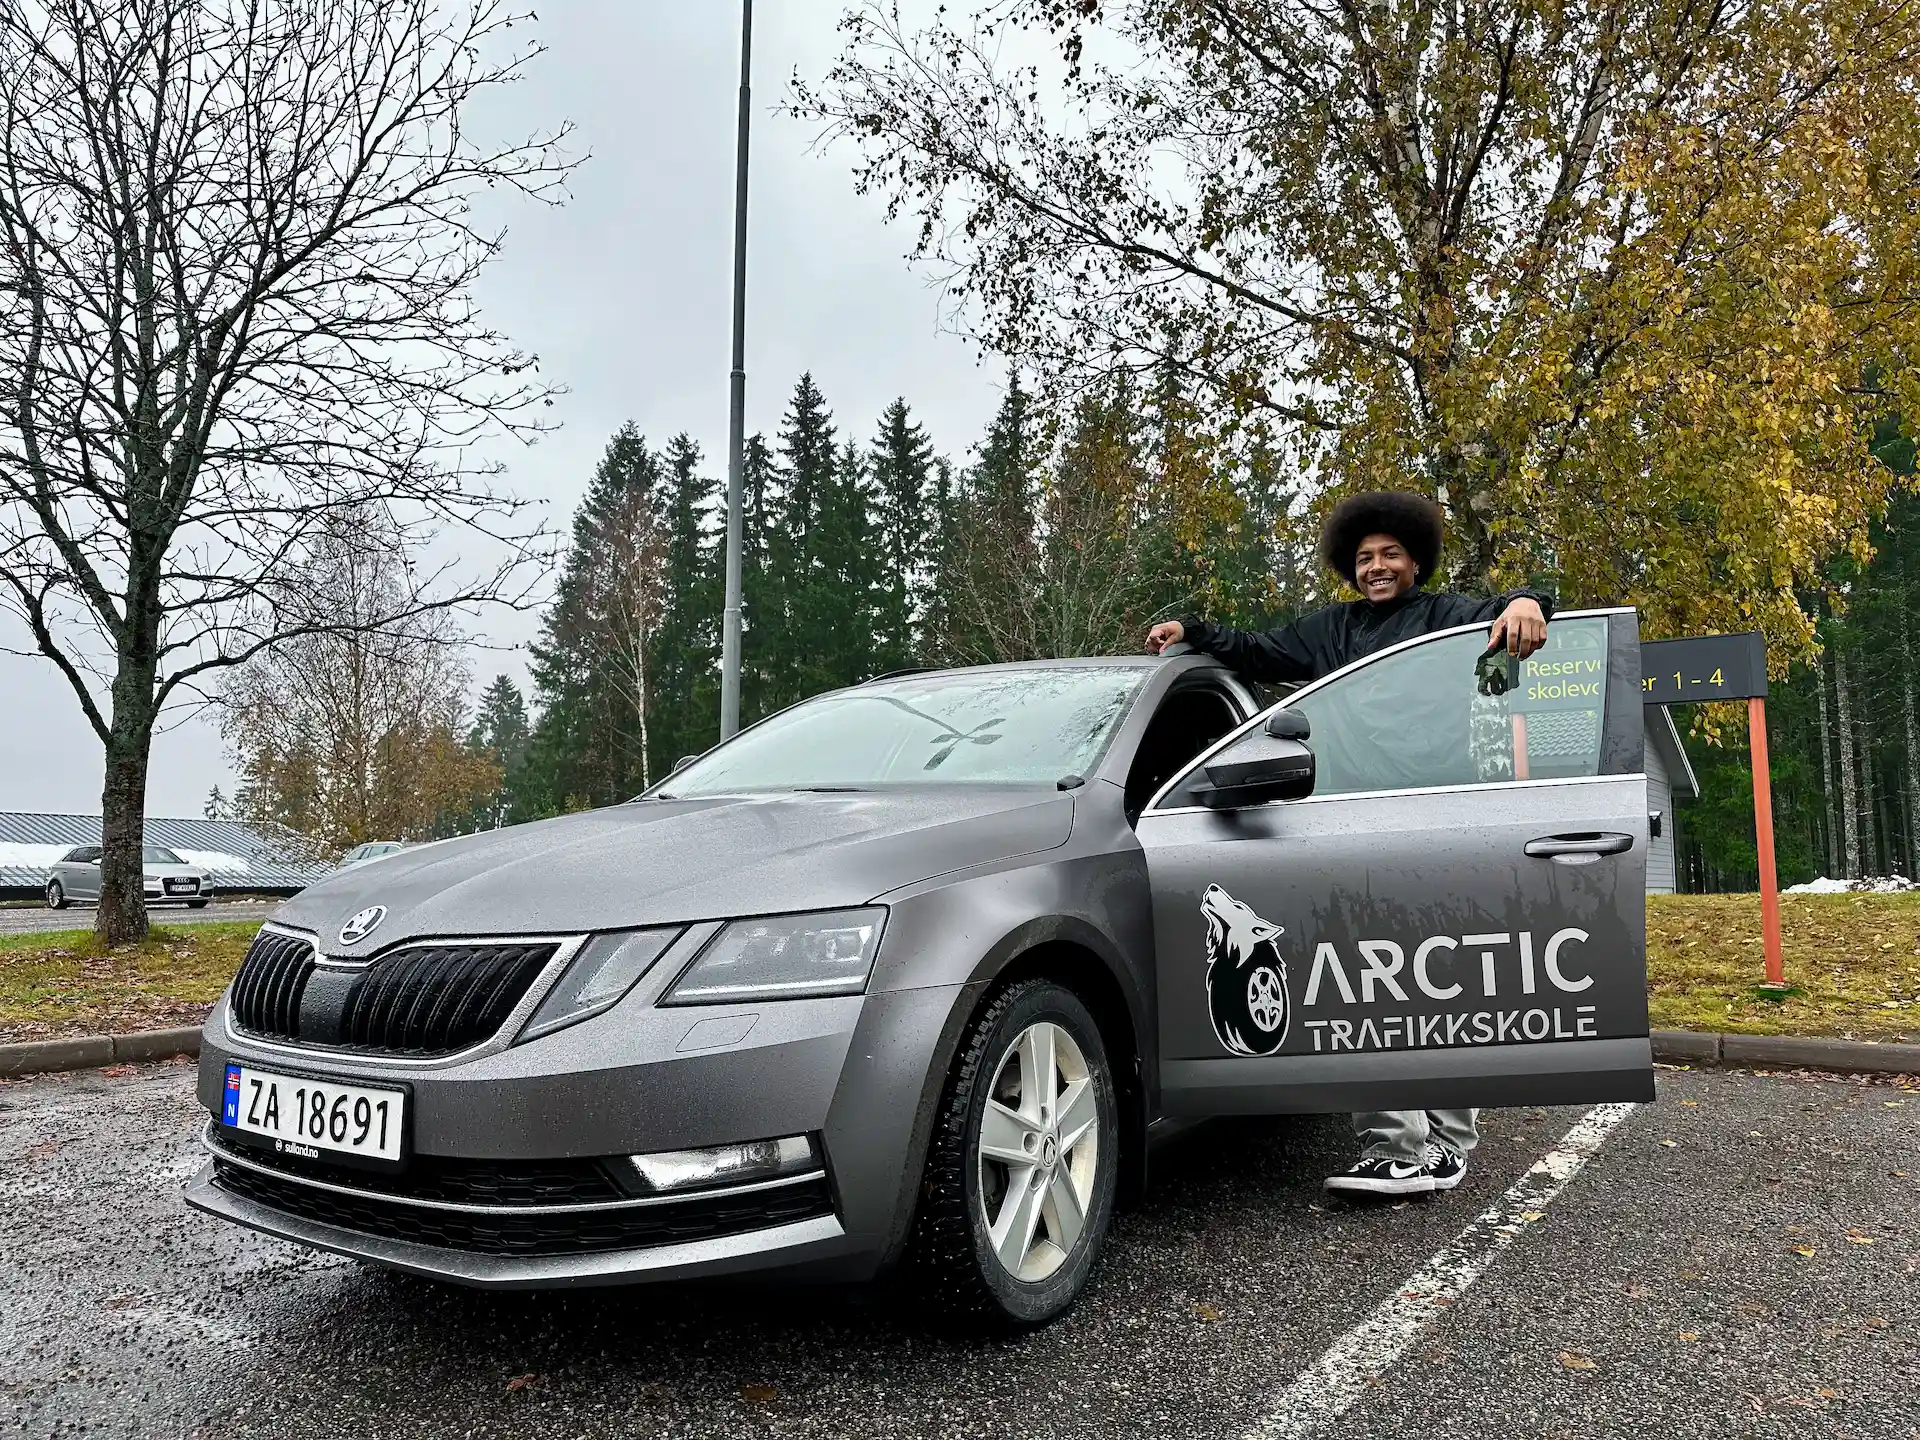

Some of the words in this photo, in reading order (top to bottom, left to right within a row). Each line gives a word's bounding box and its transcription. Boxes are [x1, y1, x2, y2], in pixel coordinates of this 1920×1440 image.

[1673, 672, 1682, 690] 1
[1709, 668, 1724, 687] 4
[1303, 928, 1595, 1006] ARCTIC
[1304, 1005, 1598, 1051] TRAFIKKSKOLE
[227, 1103, 235, 1117] N
[247, 1078, 279, 1130] ZA
[296, 1088, 389, 1149] 18691
[284, 1143, 319, 1159] sulland.no
